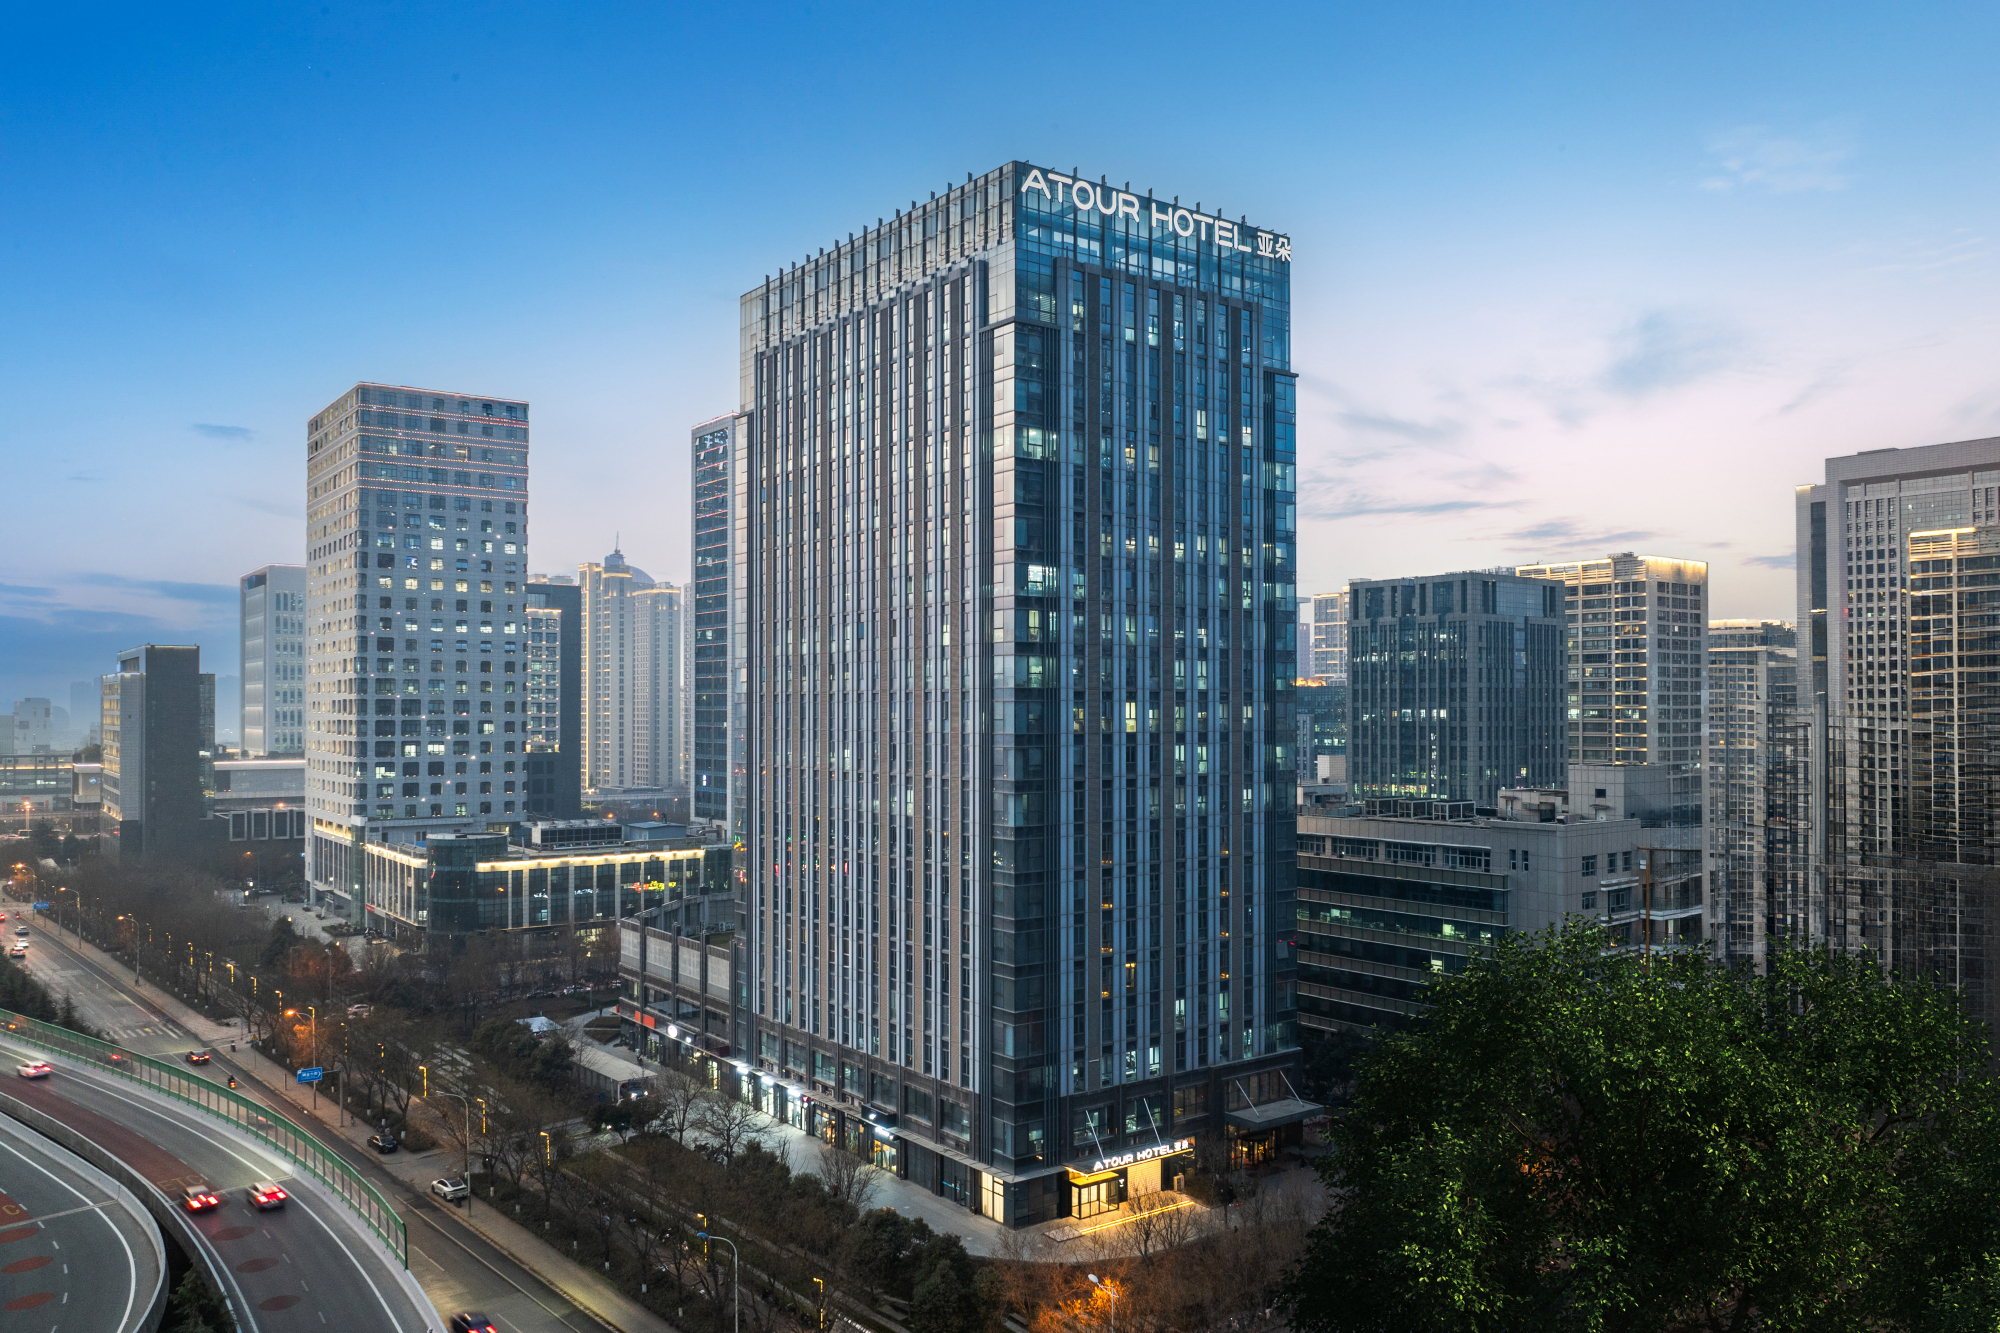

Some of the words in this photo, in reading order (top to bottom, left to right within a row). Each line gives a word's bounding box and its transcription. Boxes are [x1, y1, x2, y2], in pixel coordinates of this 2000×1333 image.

[1021, 169, 1140, 223] ATOUR
[1151, 202, 1252, 252] HOTEL
[1257, 231, 1291, 262] 亚朵
[1093, 1153, 1134, 1171] ATOUR
[1137, 1144, 1173, 1160] HOTEL
[157, 1175, 204, 1192] ETC
